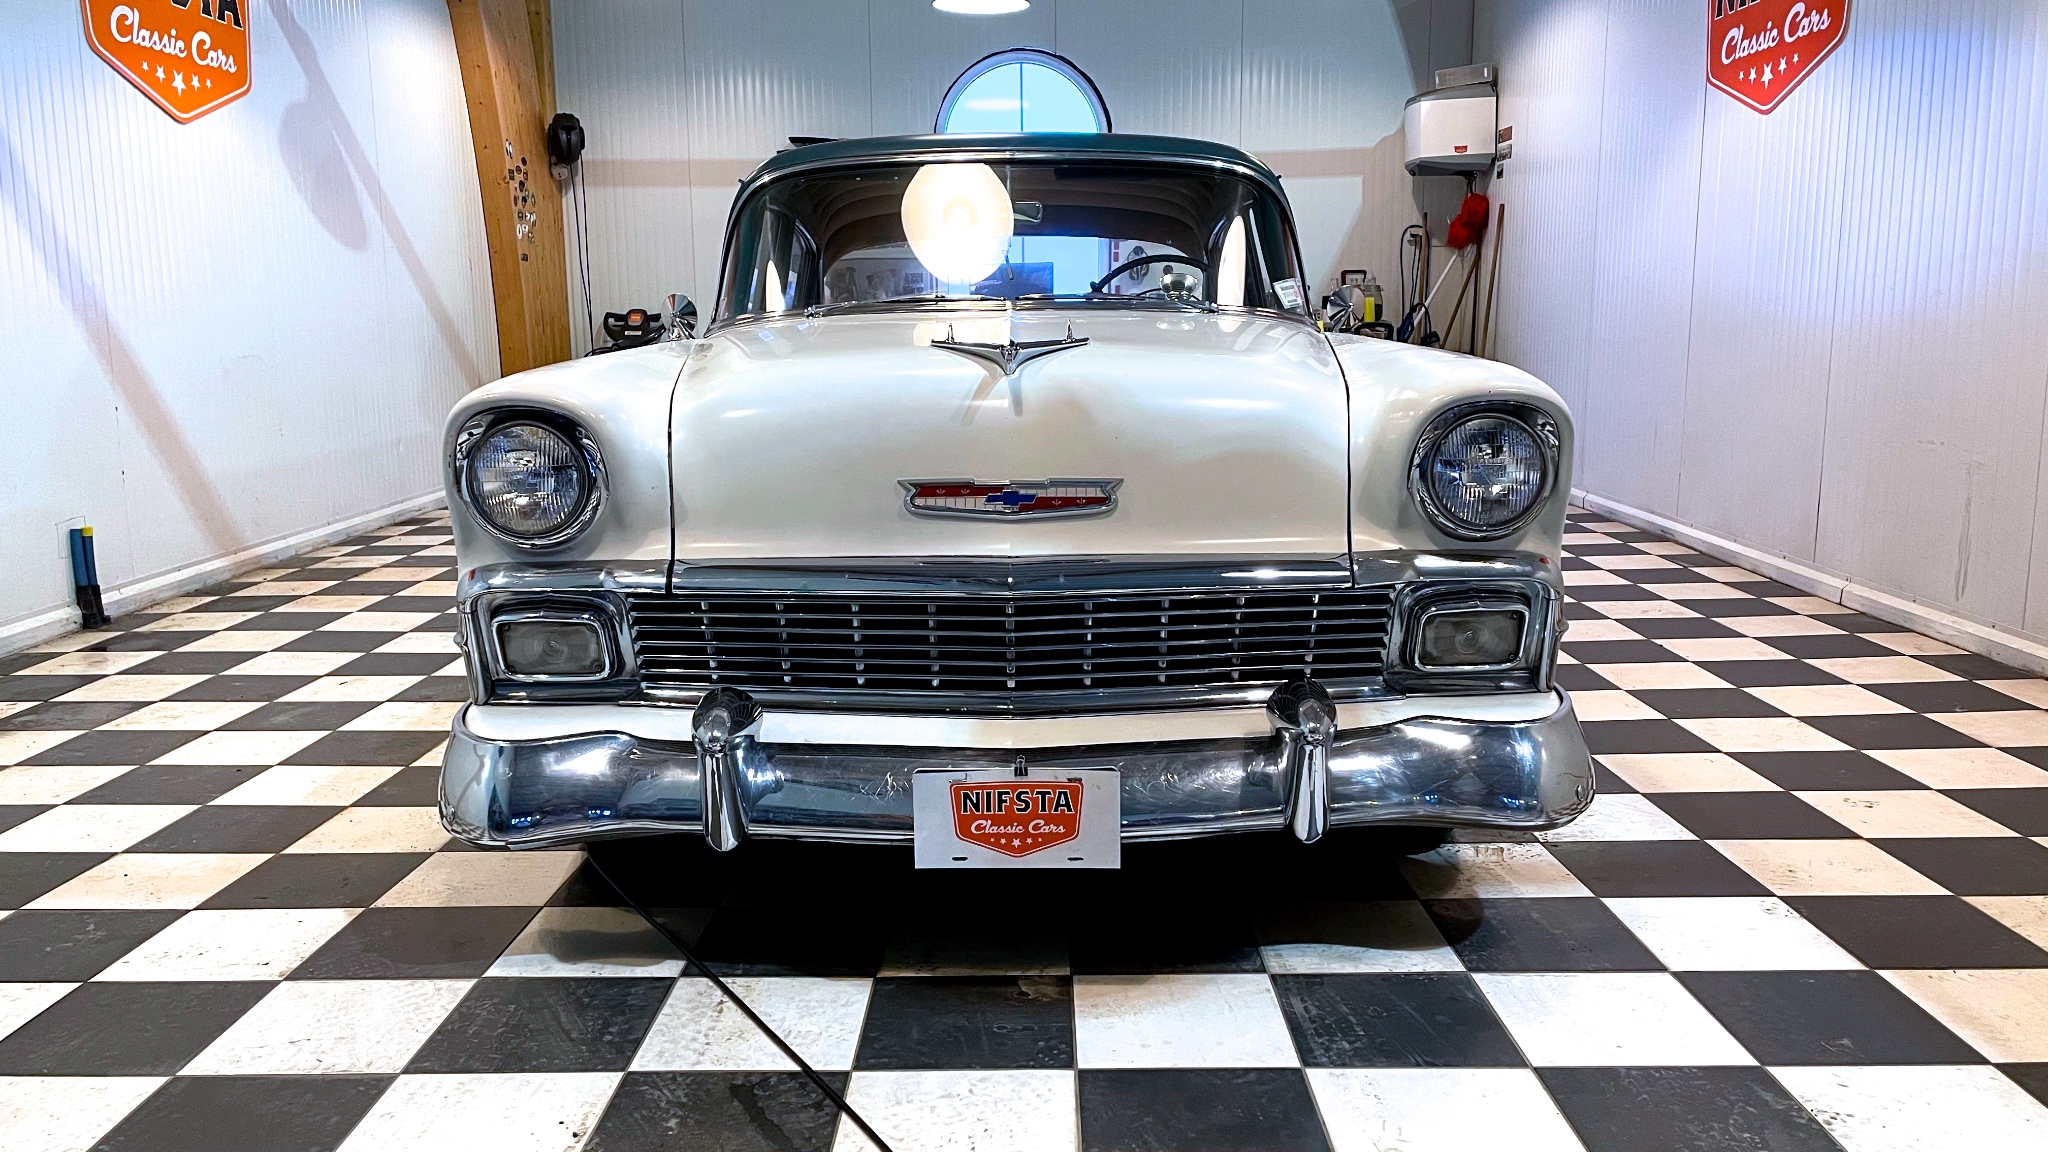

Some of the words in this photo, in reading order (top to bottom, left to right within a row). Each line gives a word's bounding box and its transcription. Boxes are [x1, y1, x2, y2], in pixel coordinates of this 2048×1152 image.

[110, 5, 188, 58] Classic
[191, 31, 237, 73] Cars
[1721, 20, 1779, 65] Classic
[1783, 2, 1831, 43] Cars
[960, 789, 1075, 815] NIFSTA
[970, 819, 1025, 834] Classic
[1028, 819, 1066, 834] Cars
